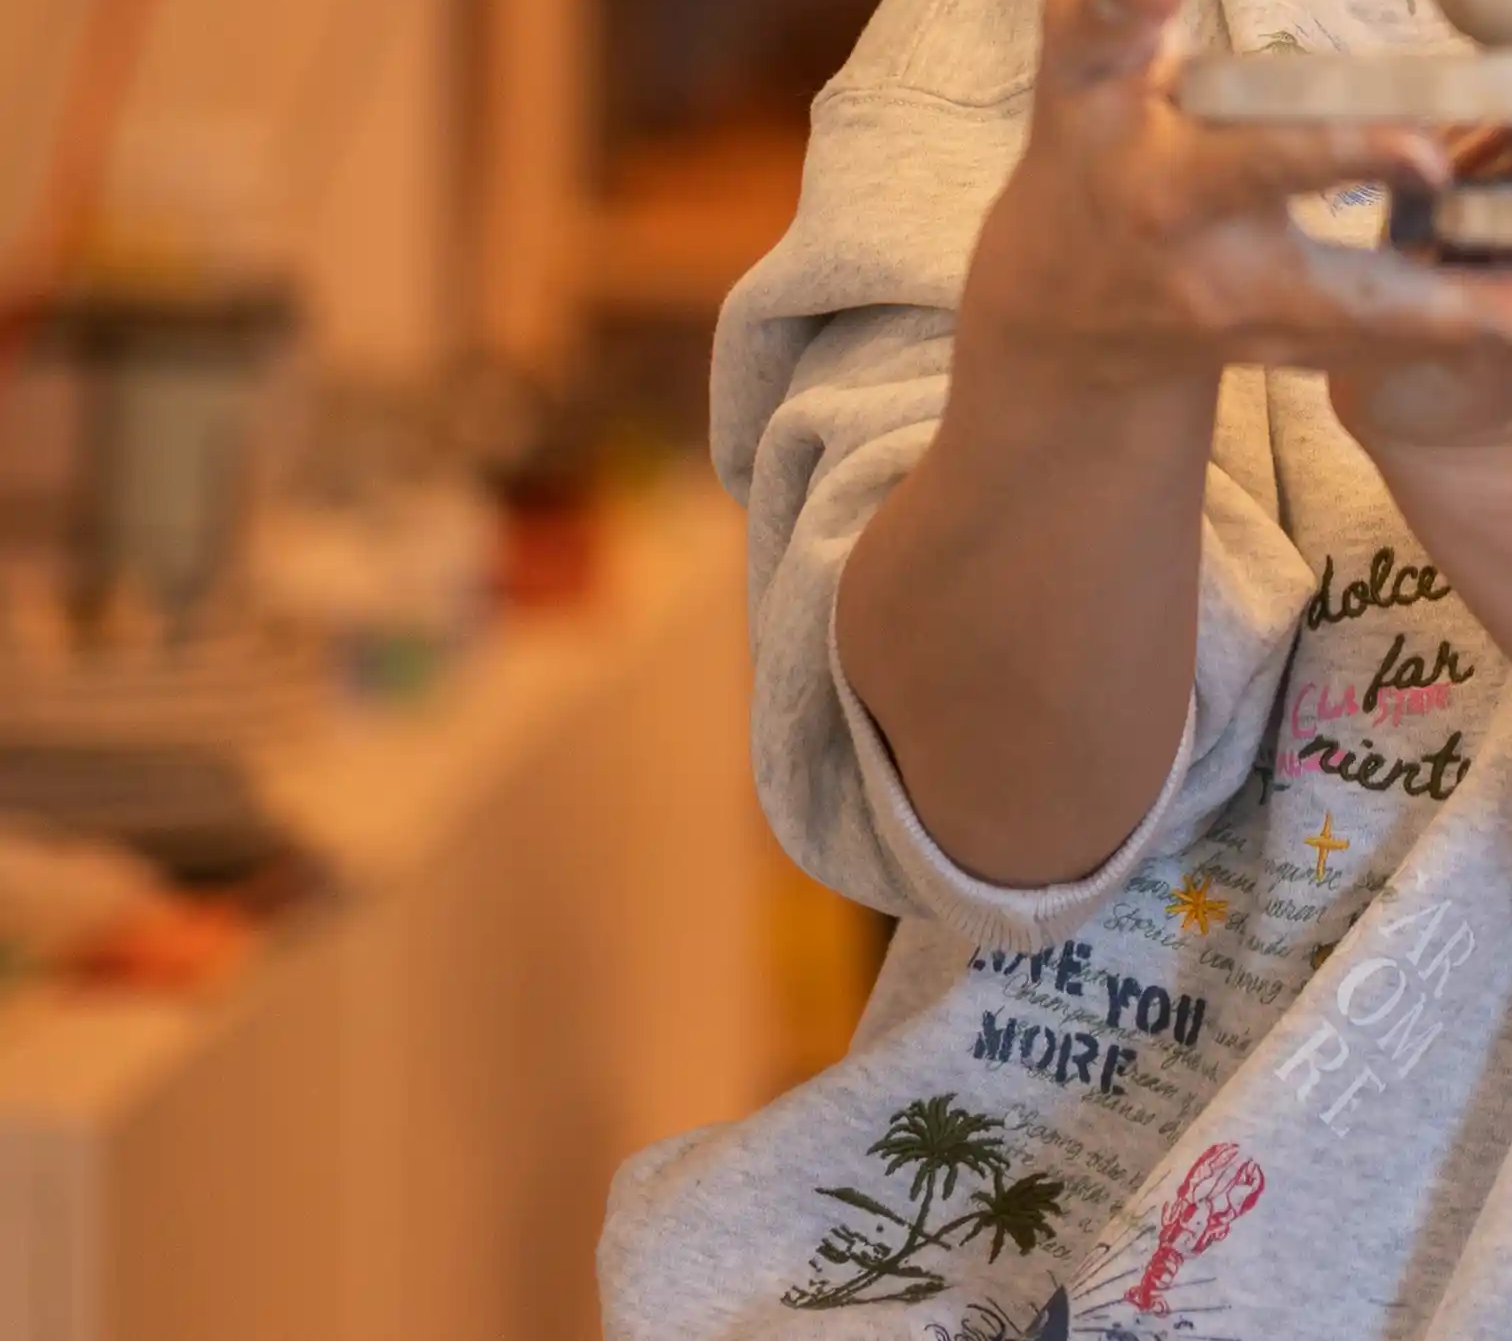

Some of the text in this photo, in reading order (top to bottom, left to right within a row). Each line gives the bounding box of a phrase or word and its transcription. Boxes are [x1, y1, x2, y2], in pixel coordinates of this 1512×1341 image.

[1306, 546, 1452, 630] dolce
[1363, 634, 1475, 713] far
[1105, 972, 1207, 1047] YOU
[972, 1009, 1138, 1096] MORE
